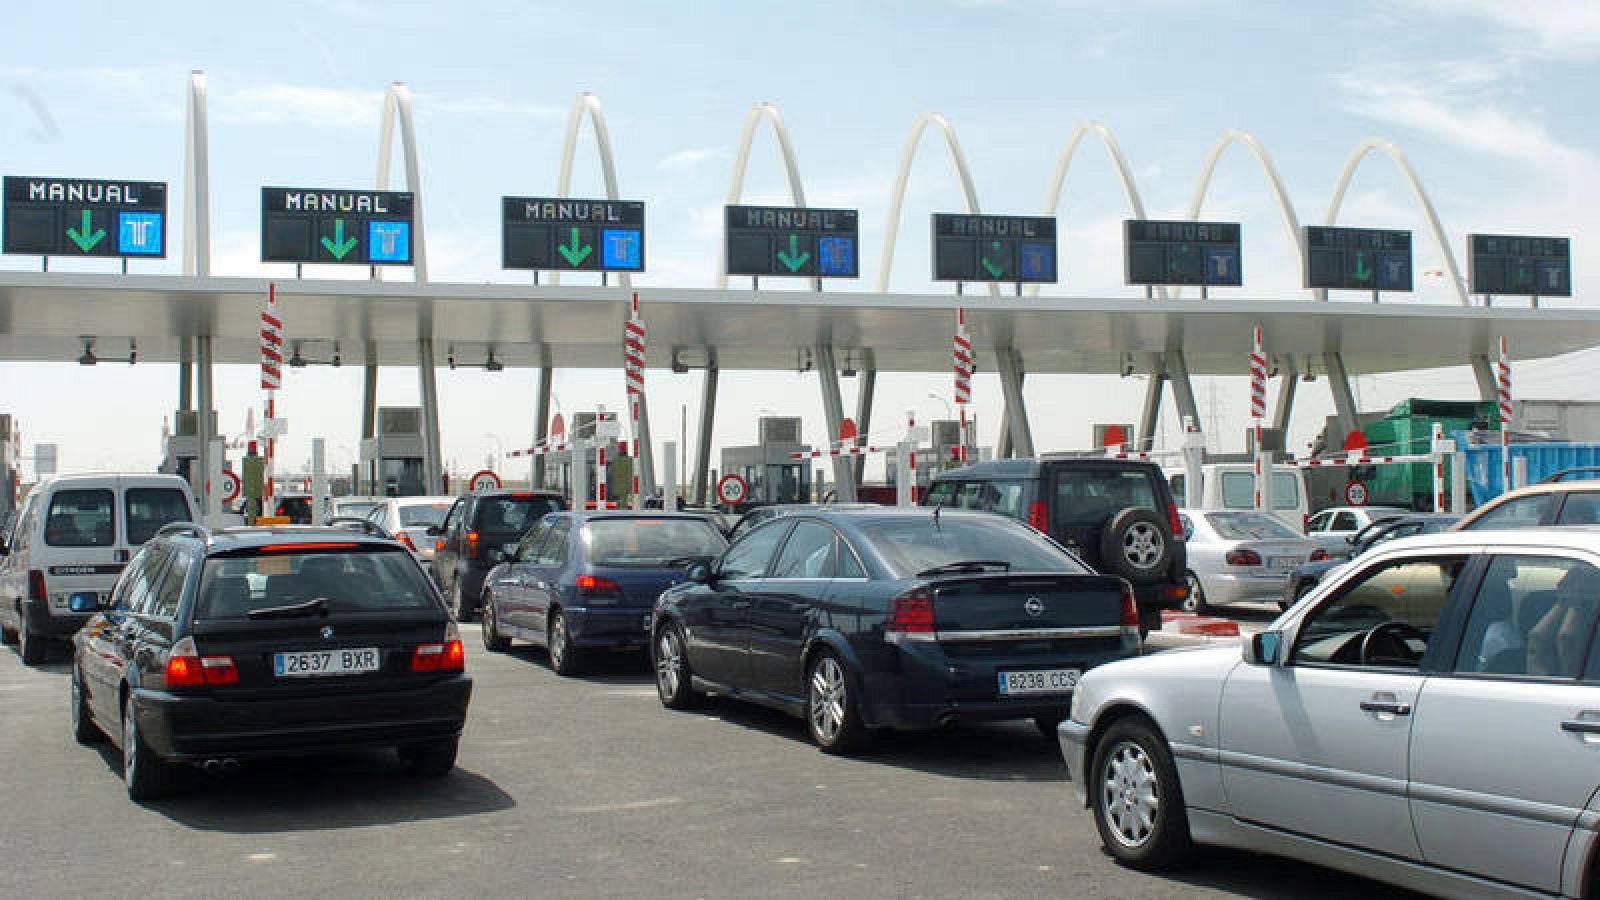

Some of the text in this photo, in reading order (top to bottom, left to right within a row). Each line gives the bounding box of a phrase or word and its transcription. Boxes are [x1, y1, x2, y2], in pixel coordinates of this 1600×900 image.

[29, 181, 138, 203] MANUAL
[285, 191, 388, 213] MANUAL
[525, 201, 621, 221] MANUAL
[747, 208, 834, 228] MANUAL
[725, 483, 741, 496] 20
[287, 651, 376, 673] 2637 BXR
